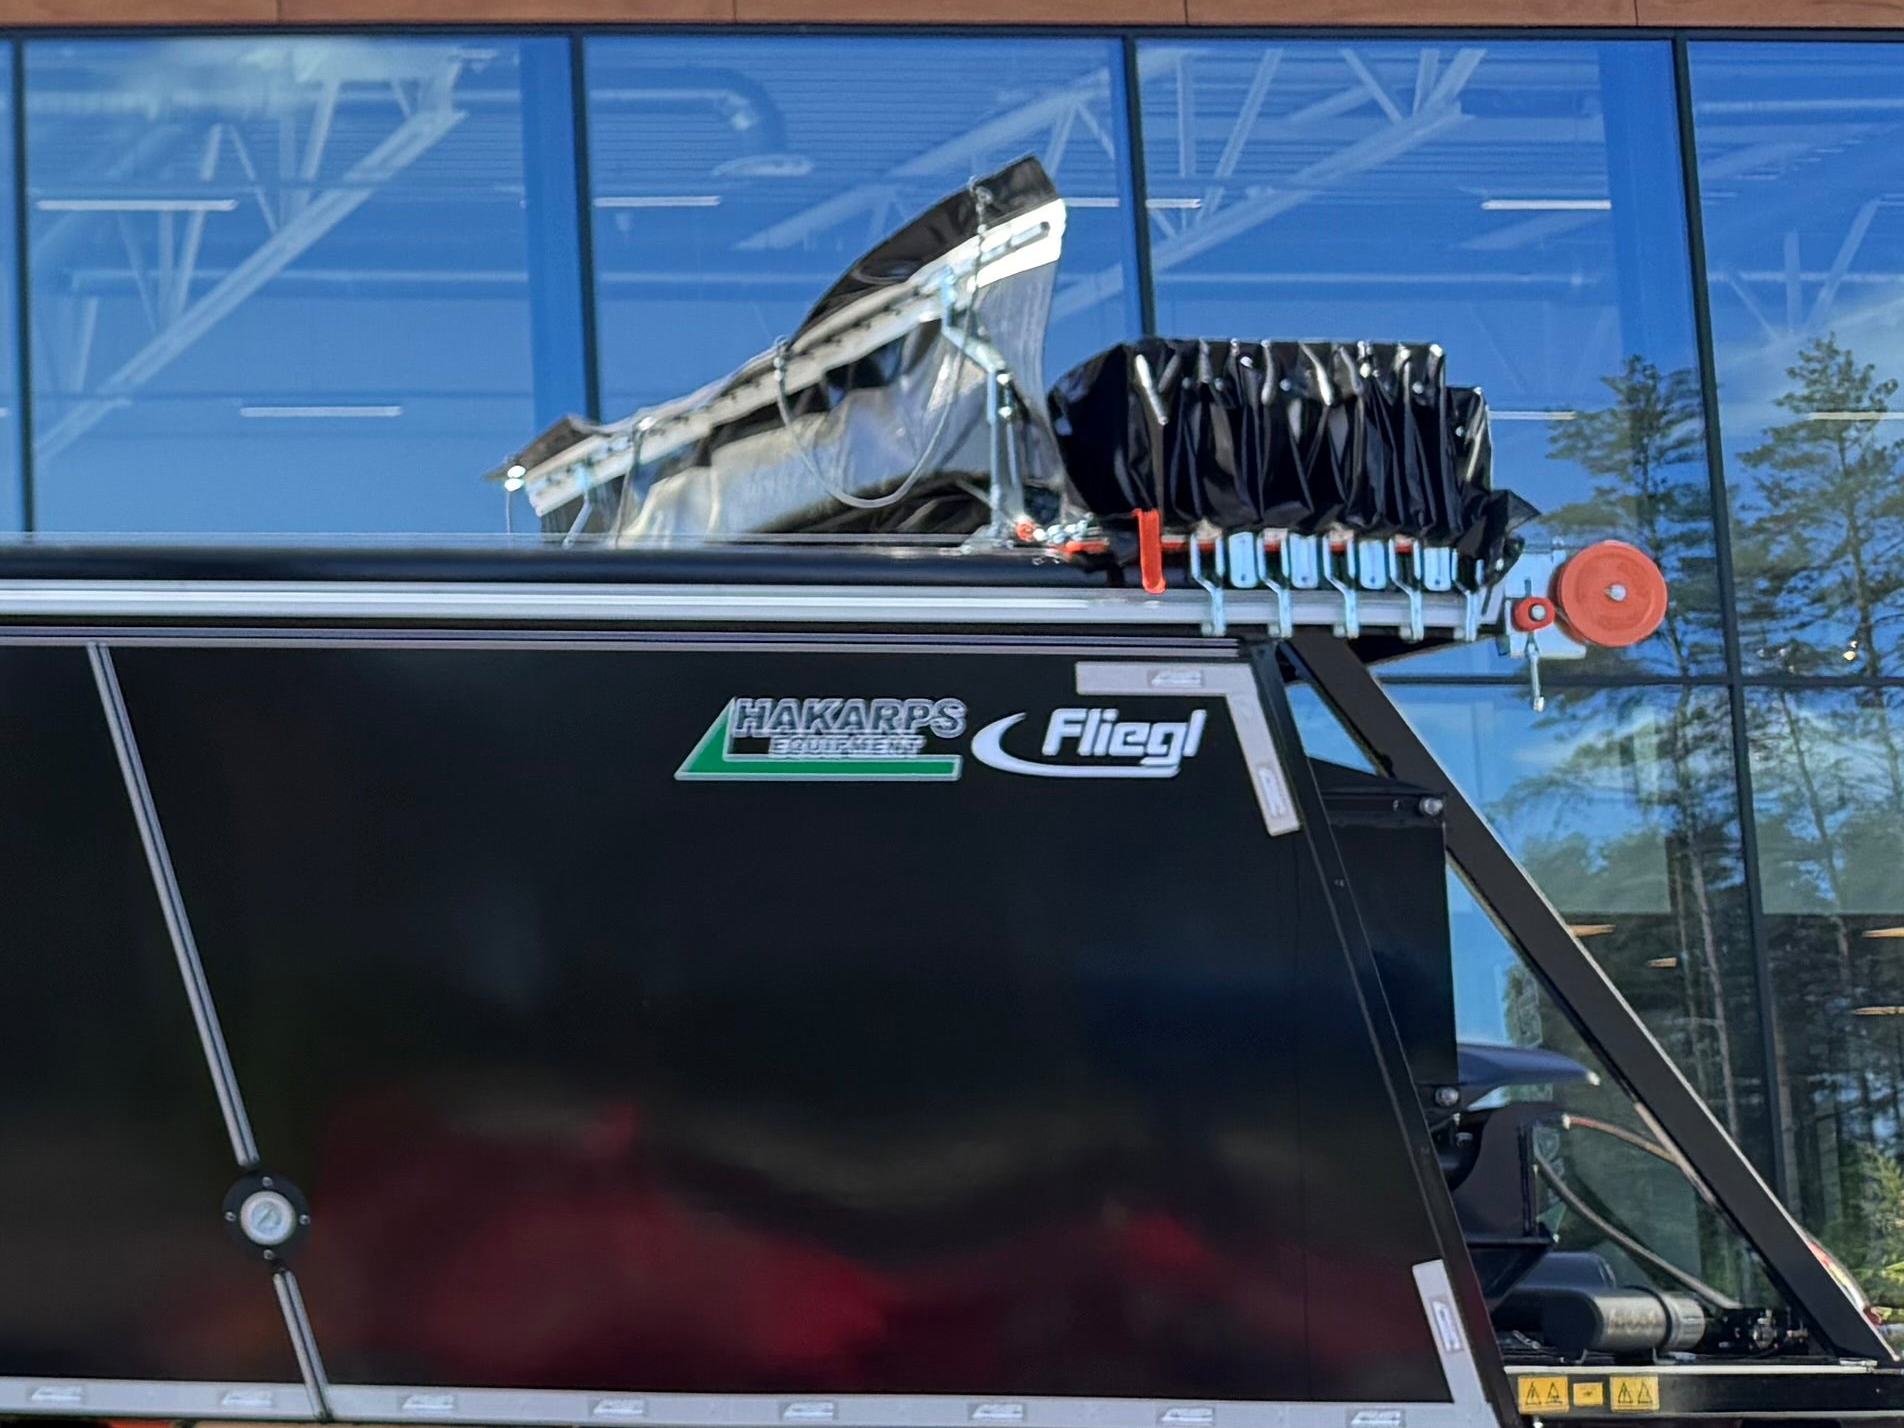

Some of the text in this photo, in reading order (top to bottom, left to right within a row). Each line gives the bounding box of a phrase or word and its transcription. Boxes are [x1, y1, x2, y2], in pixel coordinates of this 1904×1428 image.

[732, 698, 968, 738] HAKARPS
[1041, 708, 1207, 766] Fliegl
[768, 735, 927, 759] EQUIPMENT
